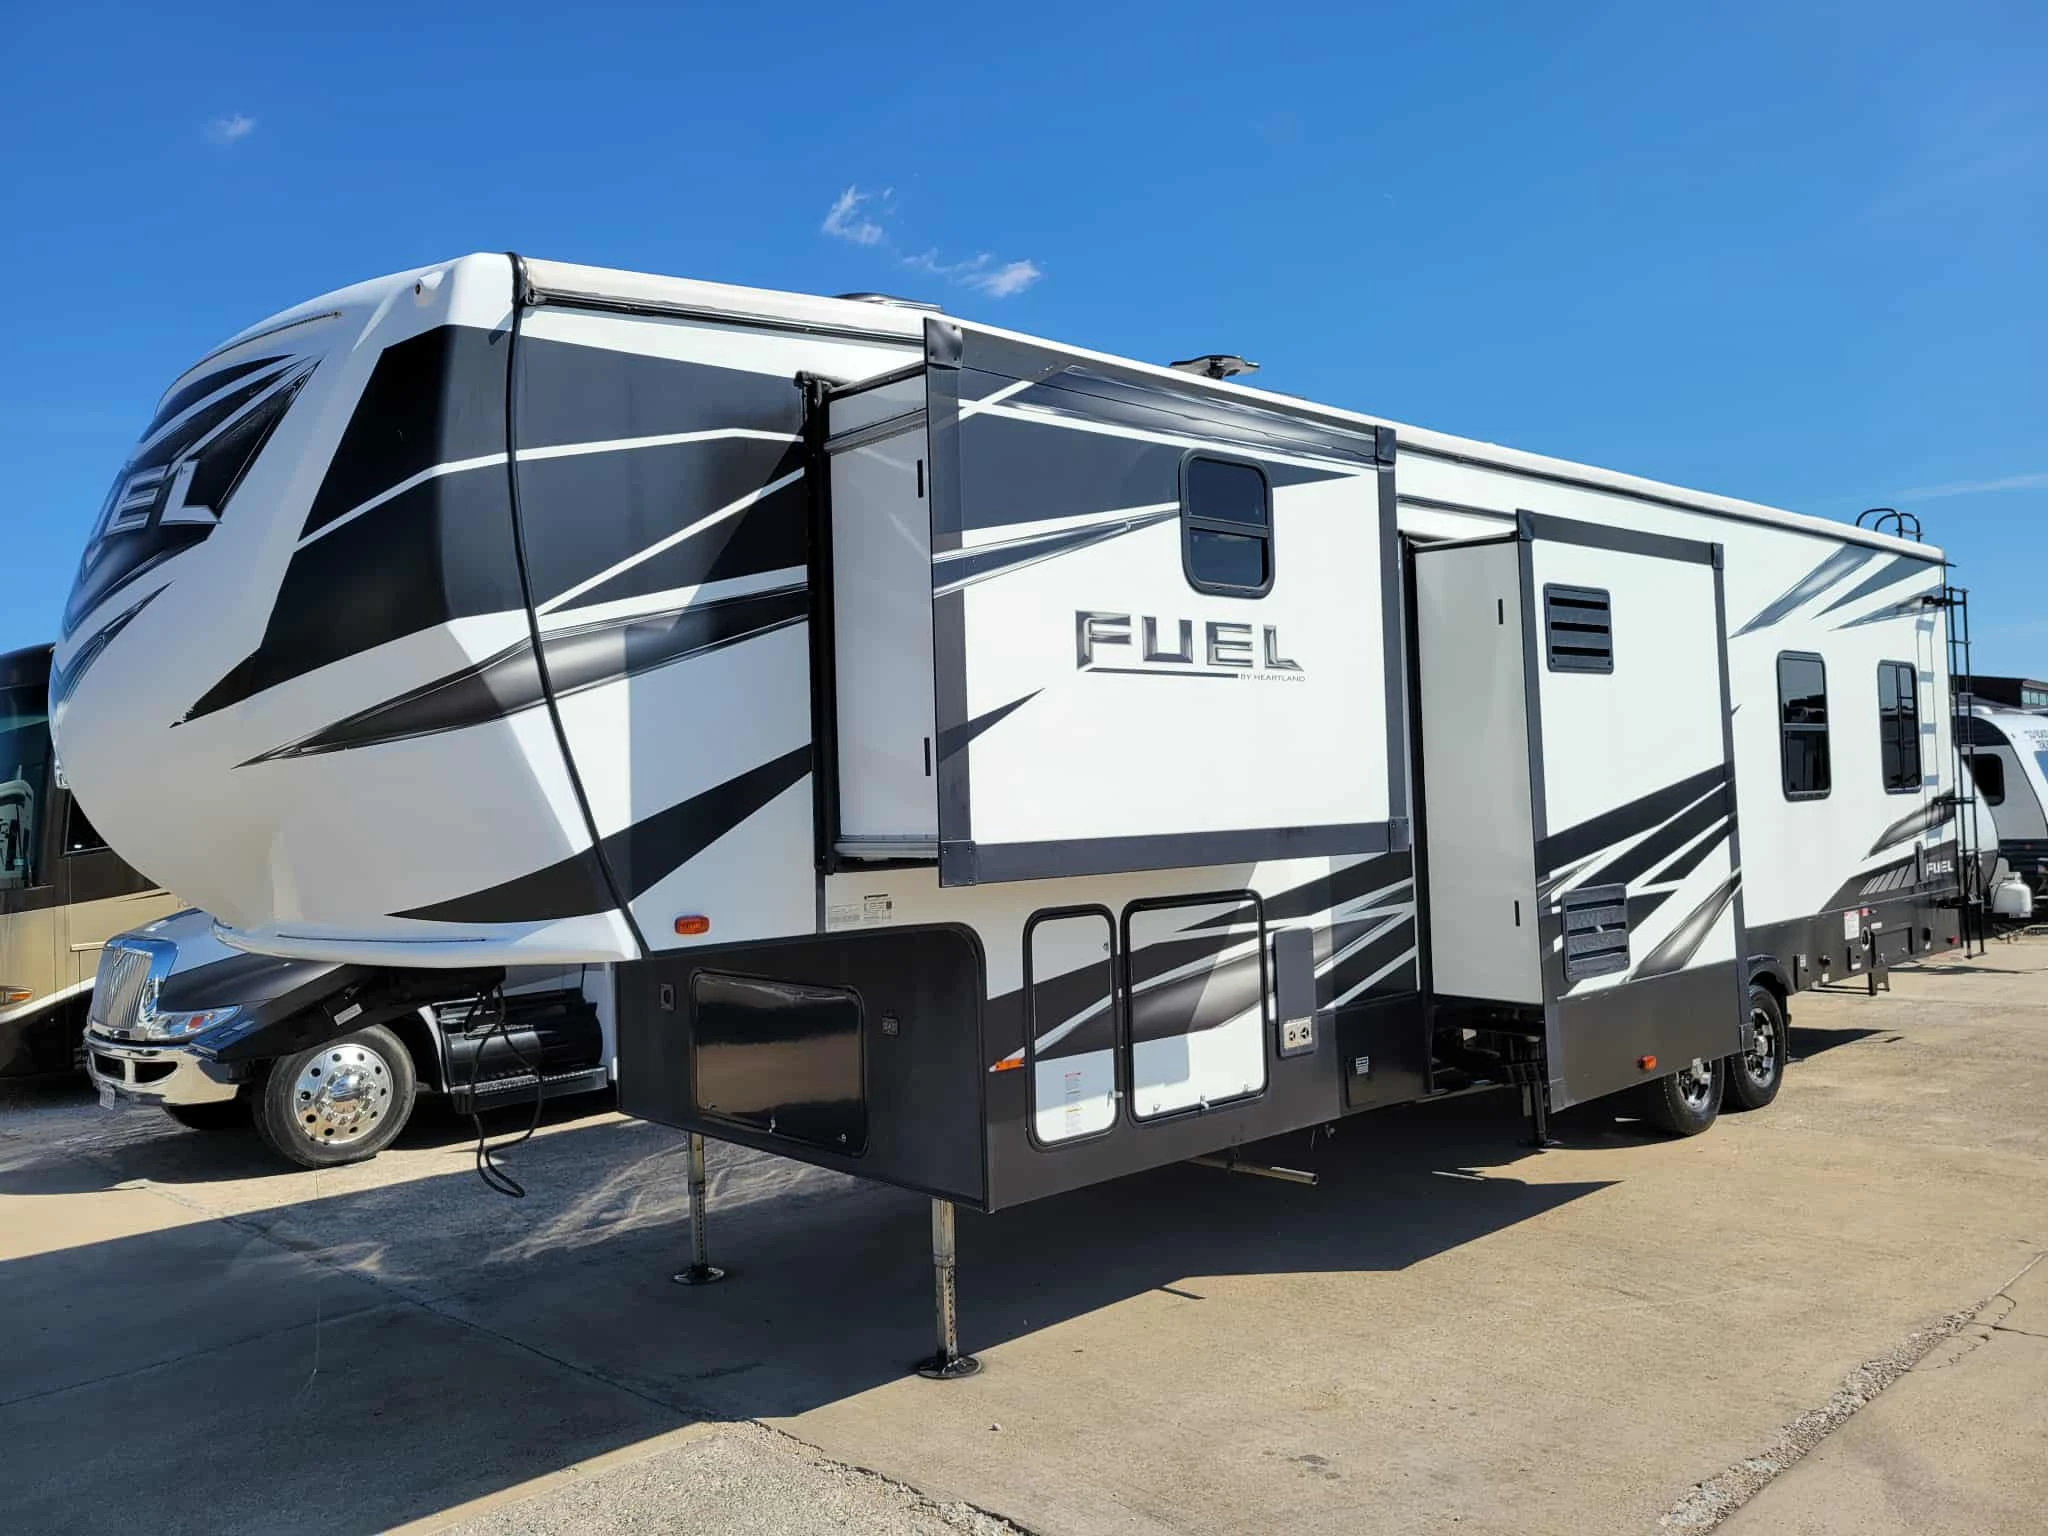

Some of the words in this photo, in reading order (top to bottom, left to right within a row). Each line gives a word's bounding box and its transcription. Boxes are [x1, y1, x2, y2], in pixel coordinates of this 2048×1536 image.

[1075, 609, 1304, 671] FUEL
[1240, 673, 1251, 681] BY
[1254, 674, 1306, 682] HEARTLAND
[1926, 860, 1954, 877] FUEL
